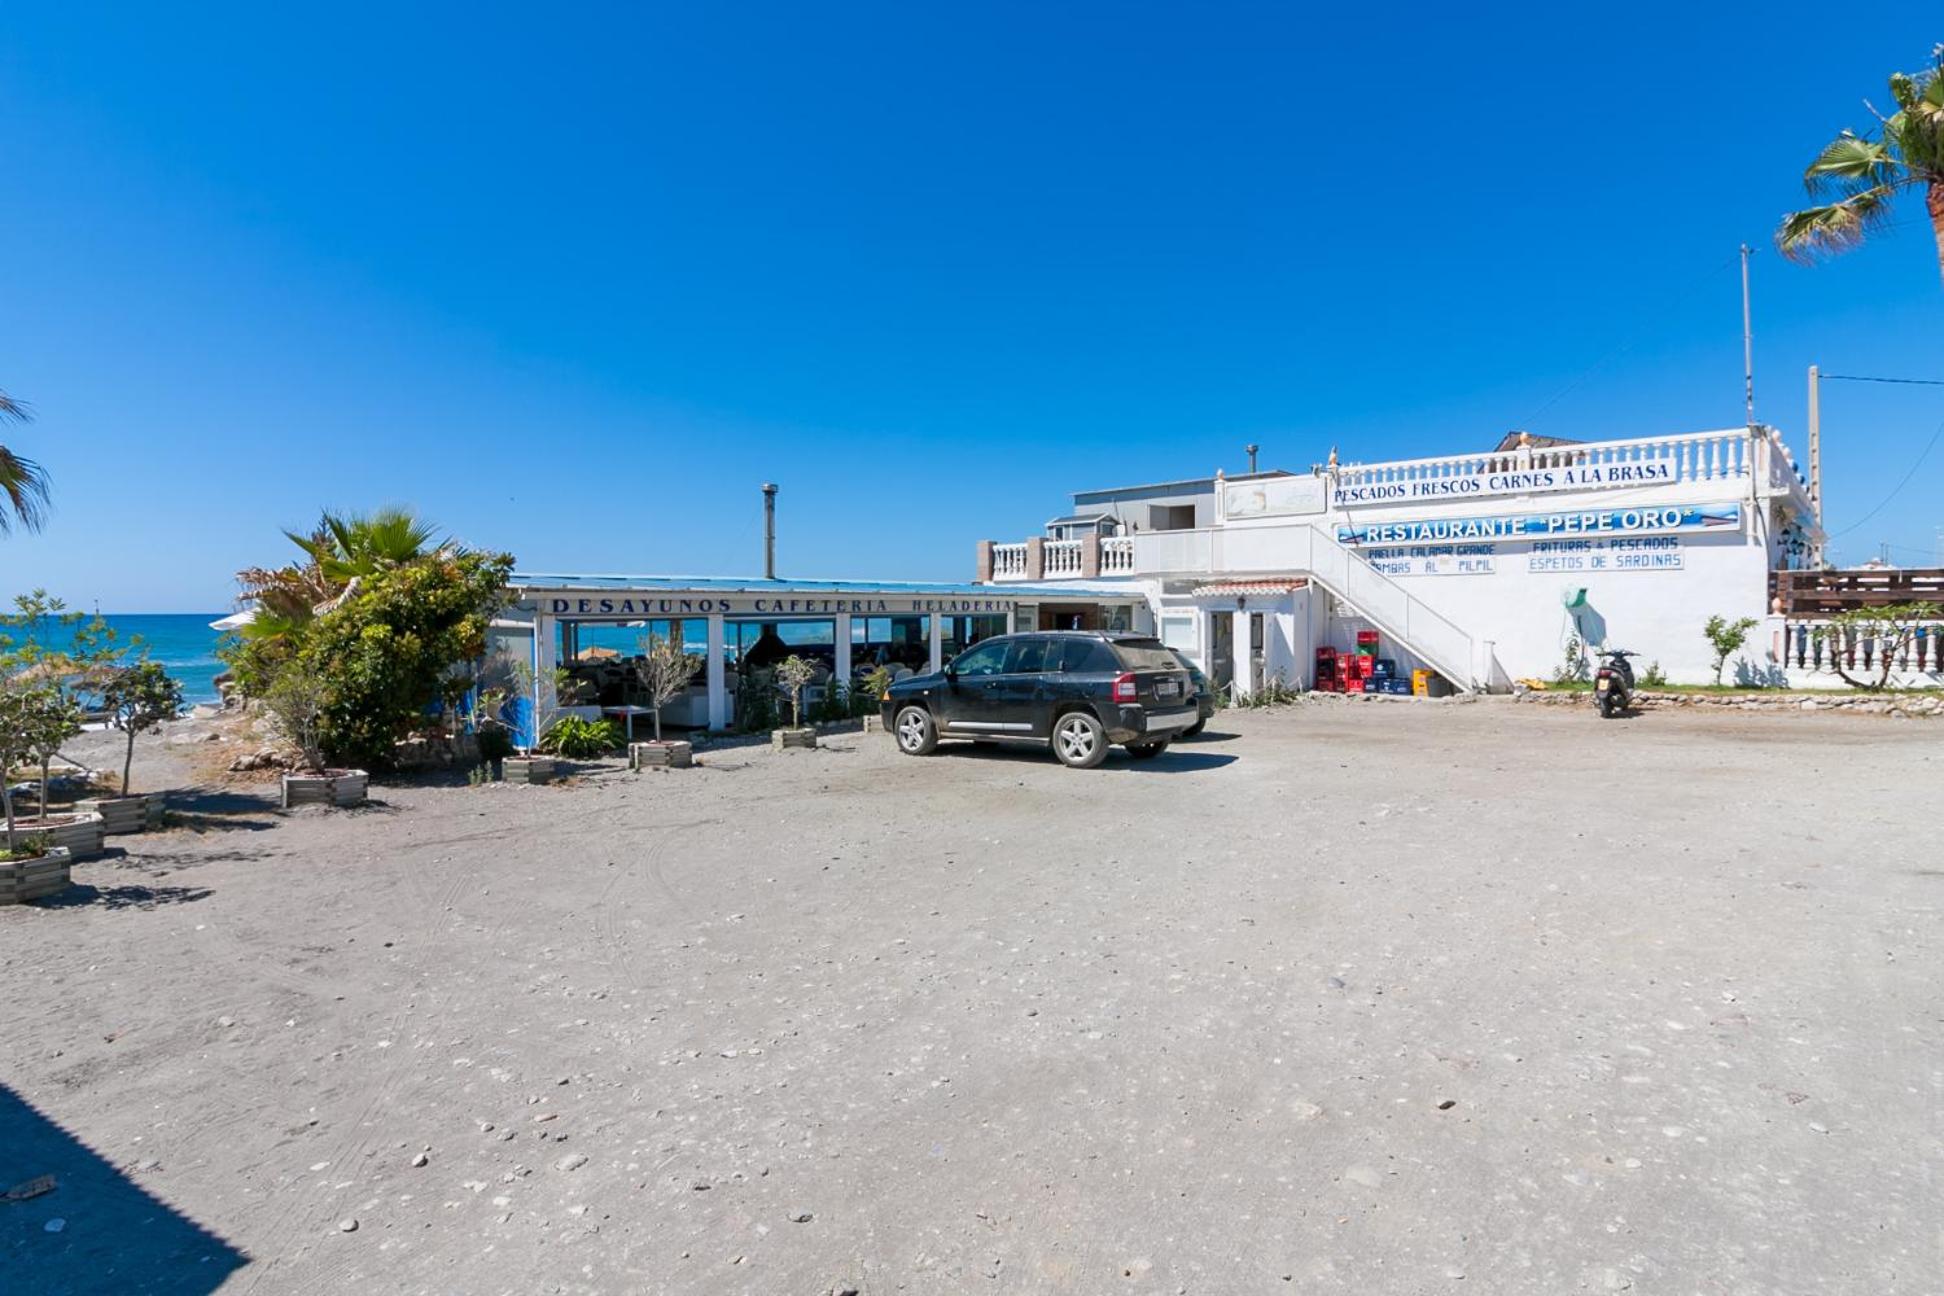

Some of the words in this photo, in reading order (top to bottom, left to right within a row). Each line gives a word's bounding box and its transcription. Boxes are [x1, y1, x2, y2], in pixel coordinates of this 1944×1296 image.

[1413, 478, 1480, 496] FRESCOS
[1489, 473, 1553, 490] CARNES
[1564, 470, 1575, 484] A
[1581, 468, 1601, 483] LA
[1608, 463, 1669, 481] BRASA
[1366, 517, 1527, 543] RESTAURANTE
[1368, 548, 1405, 560] PAELLA
[1410, 545, 1454, 559] CALAMAR
[1456, 544, 1495, 556] GRANDE
[1532, 540, 1591, 553] FRITURAS
[1610, 537, 1679, 551] PESCADOS
[1425, 561, 1438, 573] AL
[1459, 559, 1493, 572] PILPIL
[1529, 556, 1583, 570] ESPETOS
[1591, 556, 1607, 569] DE
[1616, 553, 1682, 568] SARDINAS
[552, 598, 731, 613] DESAYUNOS
[754, 599, 888, 612] CAFETERIA
[912, 600, 1014, 612] HELADERIA
